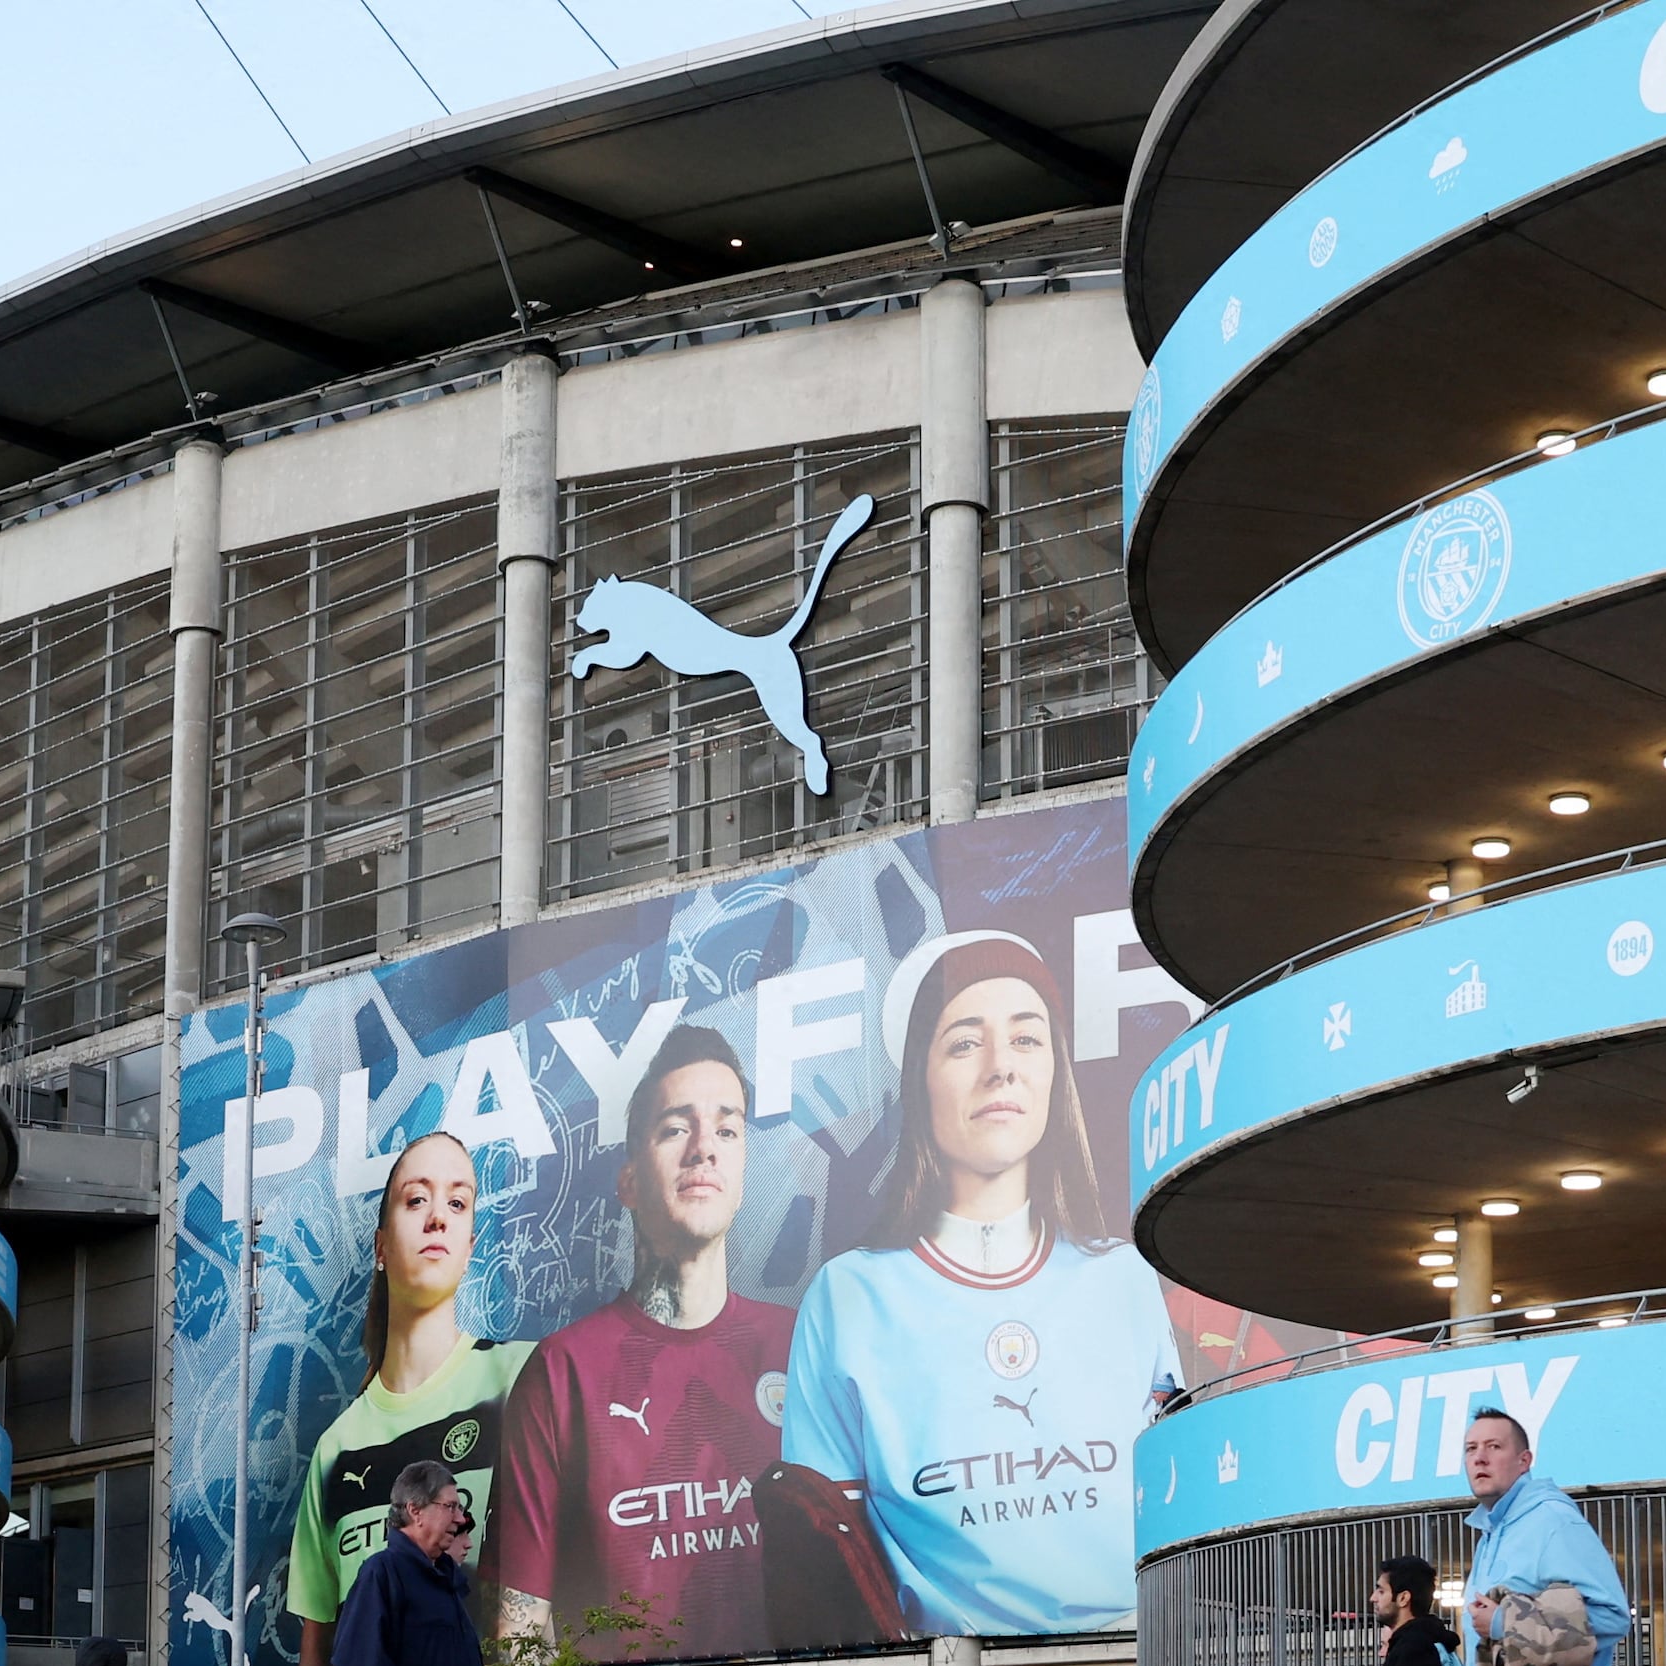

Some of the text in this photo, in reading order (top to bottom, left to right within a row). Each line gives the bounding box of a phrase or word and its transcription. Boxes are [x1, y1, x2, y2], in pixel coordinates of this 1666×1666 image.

[1413, 500, 1500, 557] MANCHESTER
[1429, 621, 1461, 639] CITY
[1611, 933, 1649, 963] 1894
[222, 997, 688, 1221] PLAY
[1143, 1023, 1230, 1171] CITY
[1336, 1355, 1580, 1489] CITY
[913, 1440, 1117, 1497] ETIHAD
[608, 1473, 754, 1527] ETIHA
[959, 1487, 1099, 1527] AIRWAYS
[649, 1522, 761, 1560] AIRWAY
